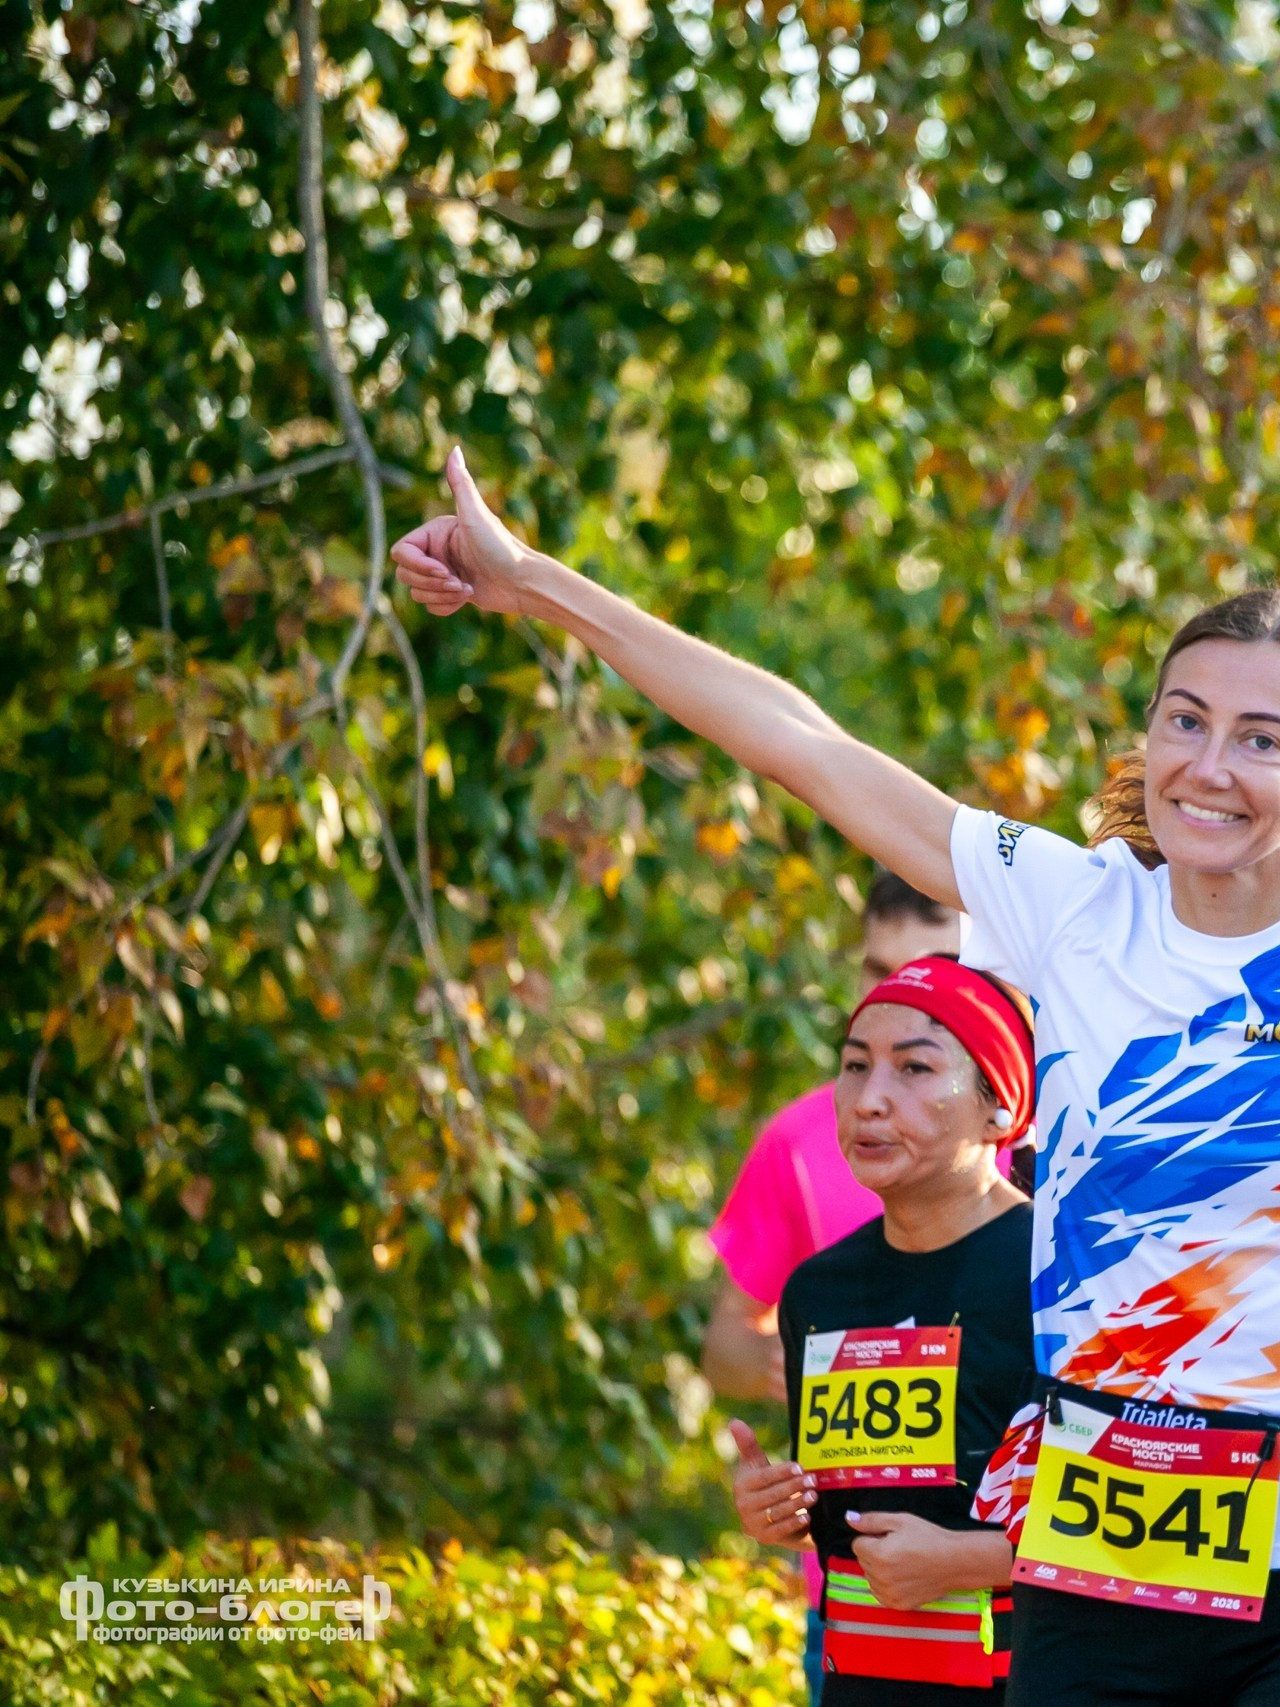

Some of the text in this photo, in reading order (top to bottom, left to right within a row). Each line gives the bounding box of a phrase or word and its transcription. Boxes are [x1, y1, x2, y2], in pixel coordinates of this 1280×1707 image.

[805, 1377, 943, 1444] 5483
[1120, 1402, 1207, 1430] Triatleta
[1068, 1423, 1093, 1437] СБЕР
[1111, 1432, 1201, 1455] КРАСНОЯРСКИЕ
[1132, 1447, 1175, 1462] МОСТЫ
[1231, 1451, 1240, 1463] 5
[1133, 1459, 1173, 1471] МАРАФОН
[1049, 1462, 1250, 1563] 5541
[1211, 1596, 1241, 1611] 2026
